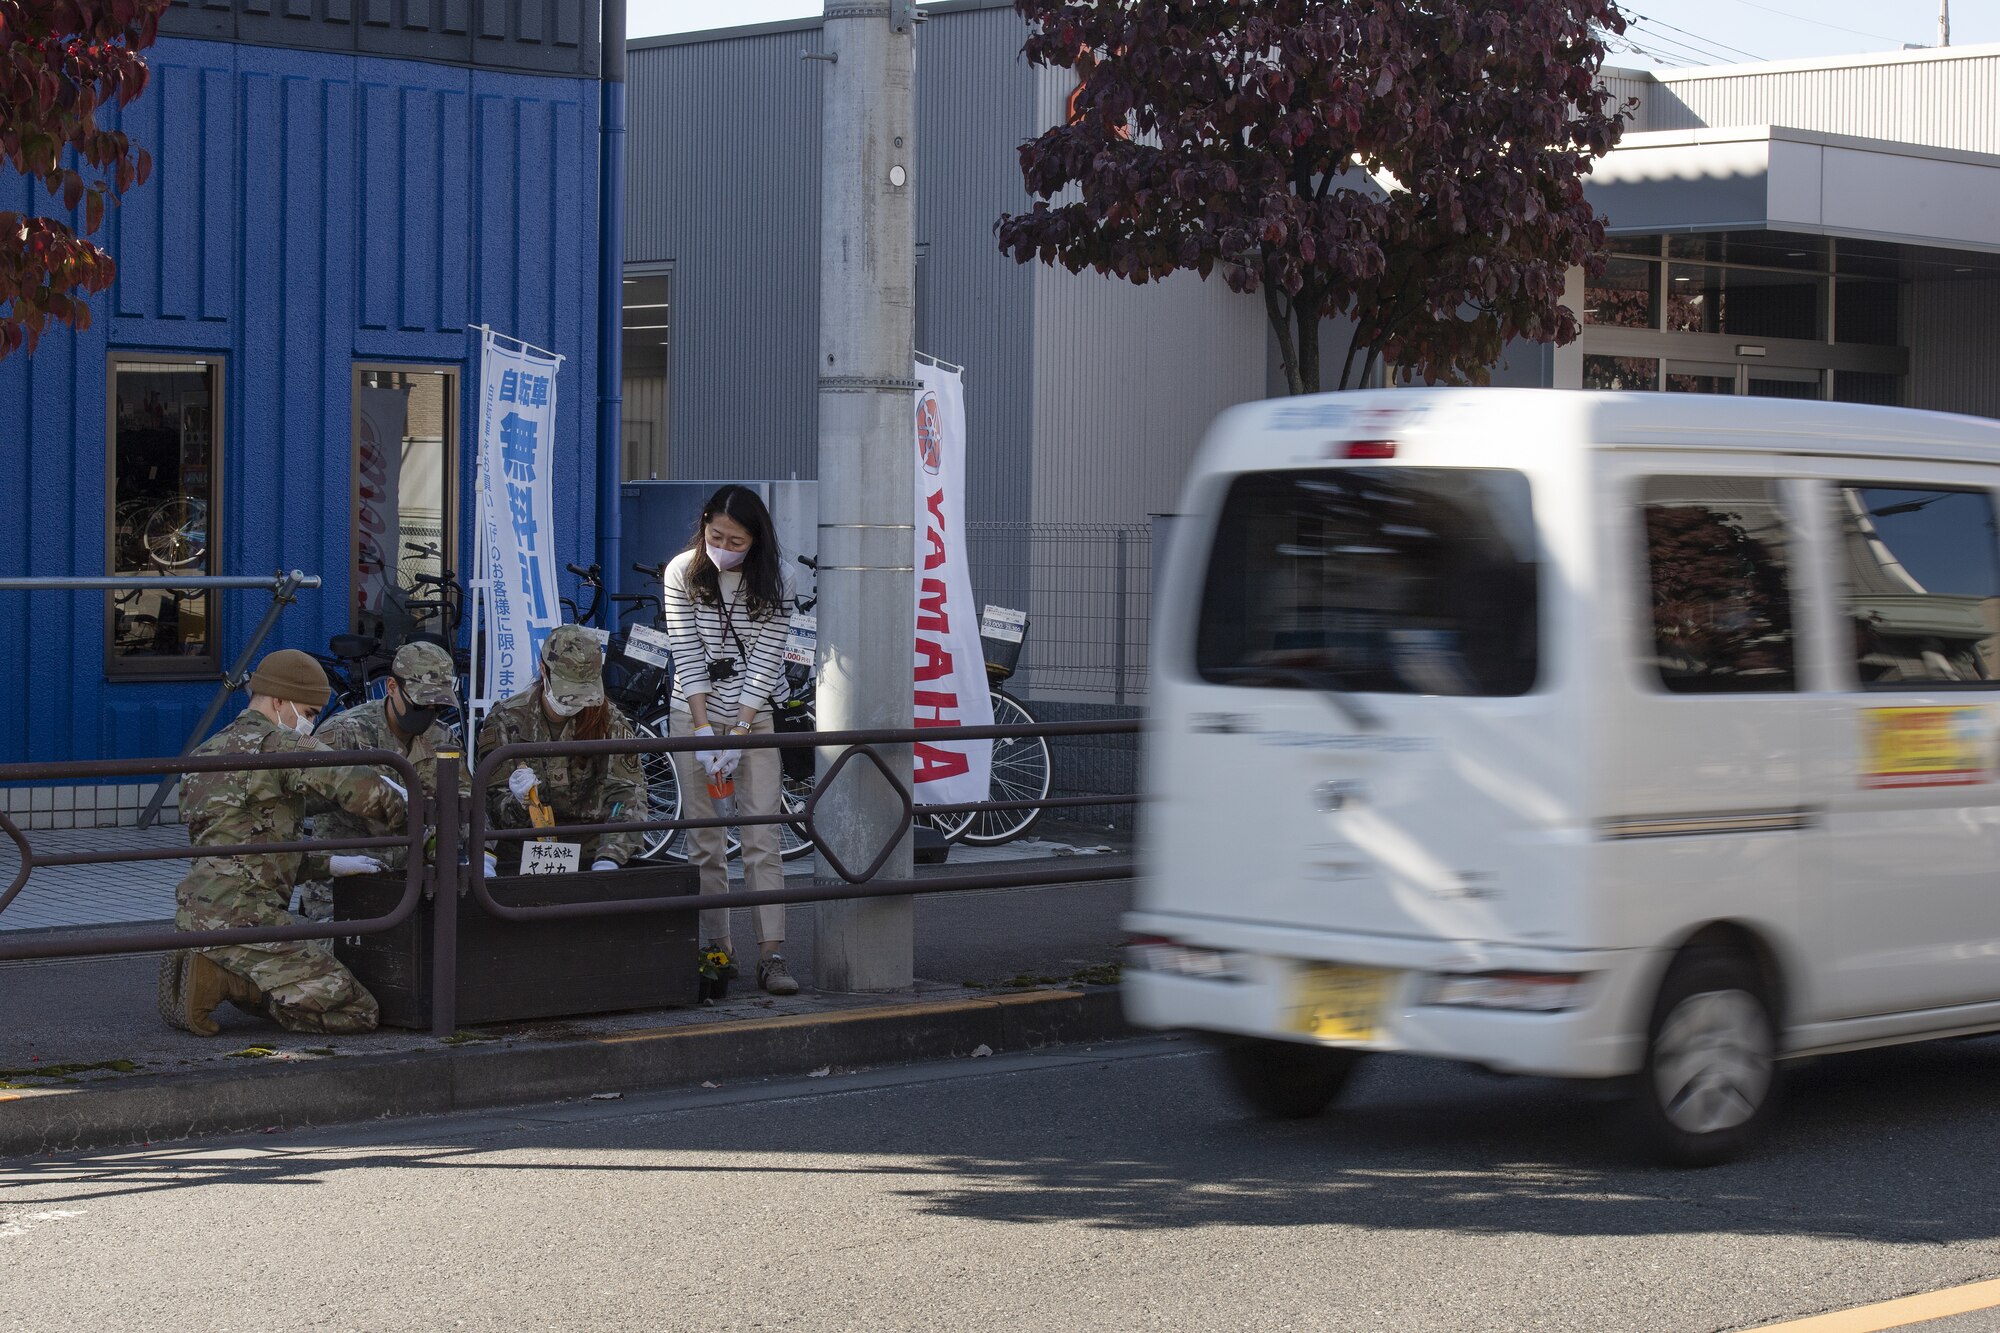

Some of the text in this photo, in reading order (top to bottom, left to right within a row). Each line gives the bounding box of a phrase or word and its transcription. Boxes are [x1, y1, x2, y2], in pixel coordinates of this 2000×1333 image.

[499, 368, 550, 410] 自転車
[914, 488, 970, 784] YAMAHA
[531, 845, 573, 859] 株式会社
[529, 861, 567, 875] ヤサカ
